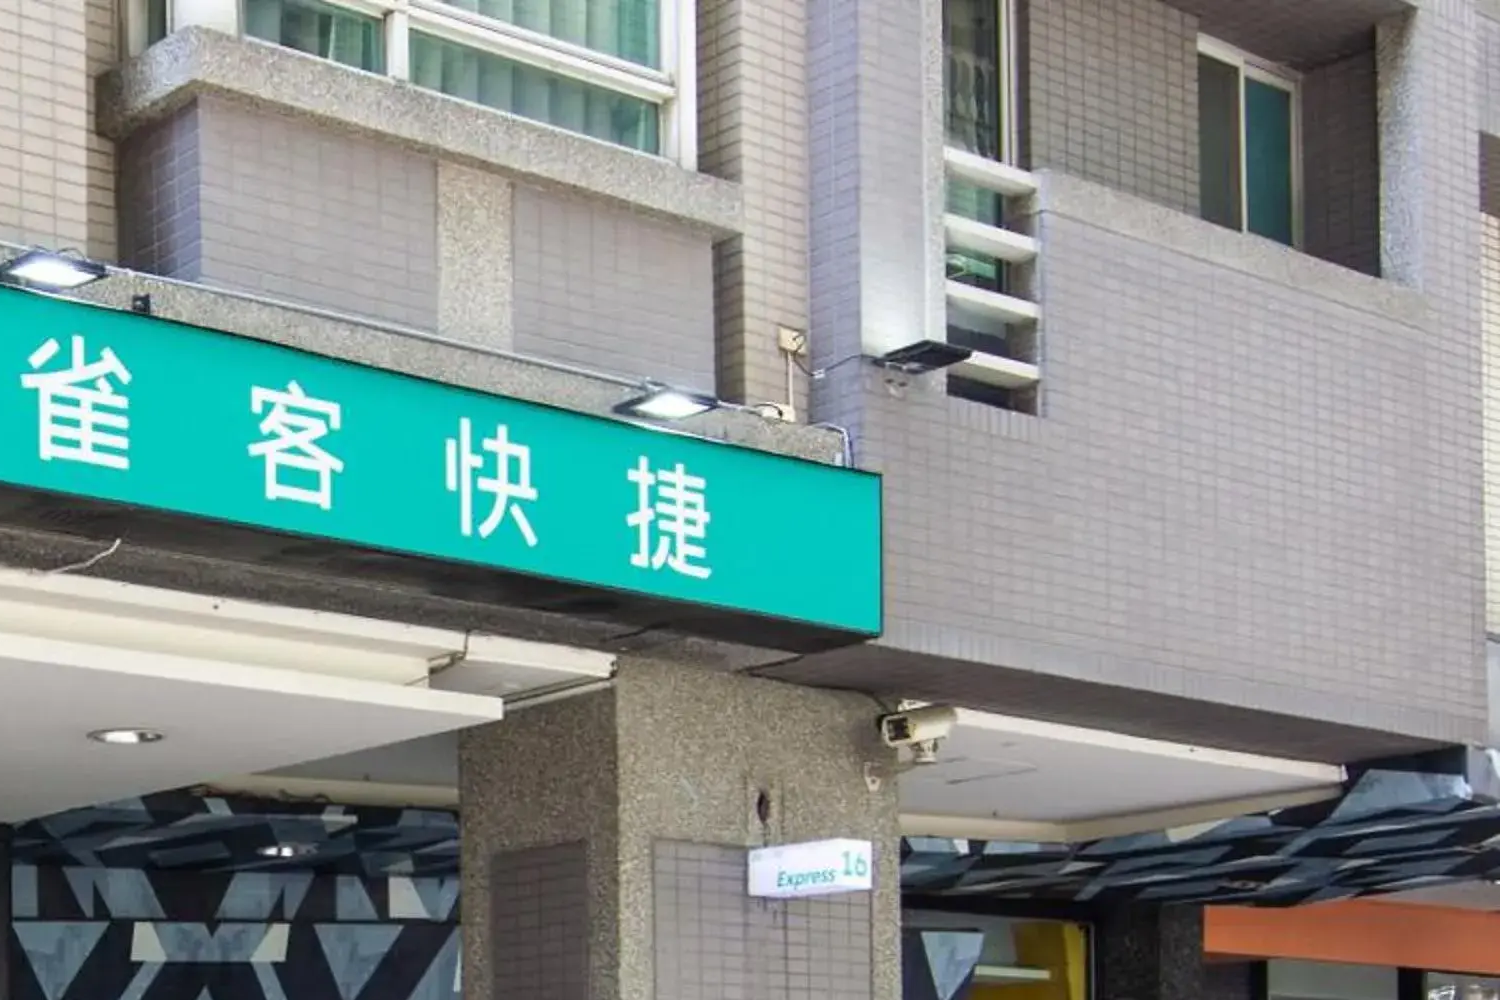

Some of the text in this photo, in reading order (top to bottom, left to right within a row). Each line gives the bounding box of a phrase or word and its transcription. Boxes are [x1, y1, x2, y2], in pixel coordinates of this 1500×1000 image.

[20, 335, 713, 580] 雀客快捷
[777, 851, 867, 890] Express 16
